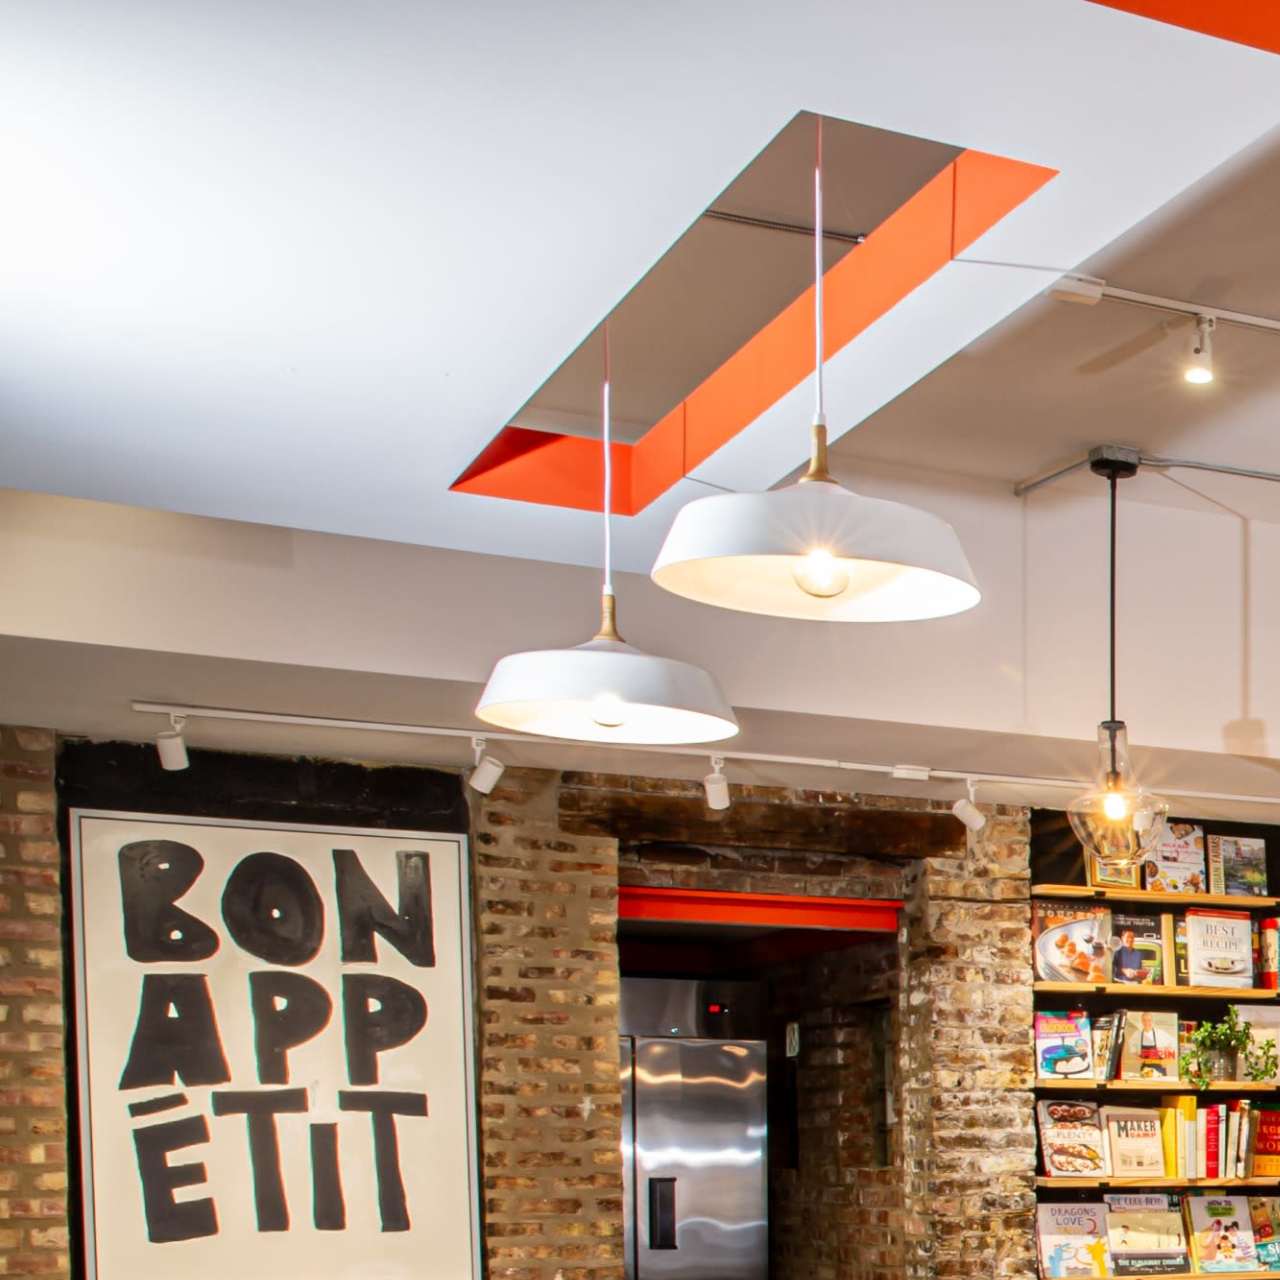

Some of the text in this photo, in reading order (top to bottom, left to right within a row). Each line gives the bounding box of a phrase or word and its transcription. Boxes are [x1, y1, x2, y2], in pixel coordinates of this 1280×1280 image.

[118, 839, 436, 968] BON
[1205, 924, 1236, 936] BEST
[118, 970, 428, 1090] APP
[1117, 1120, 1156, 1137] MAKER
[1050, 1208, 1096, 1216] DRAGONS
[1056, 1217, 1084, 1225] LOVE
